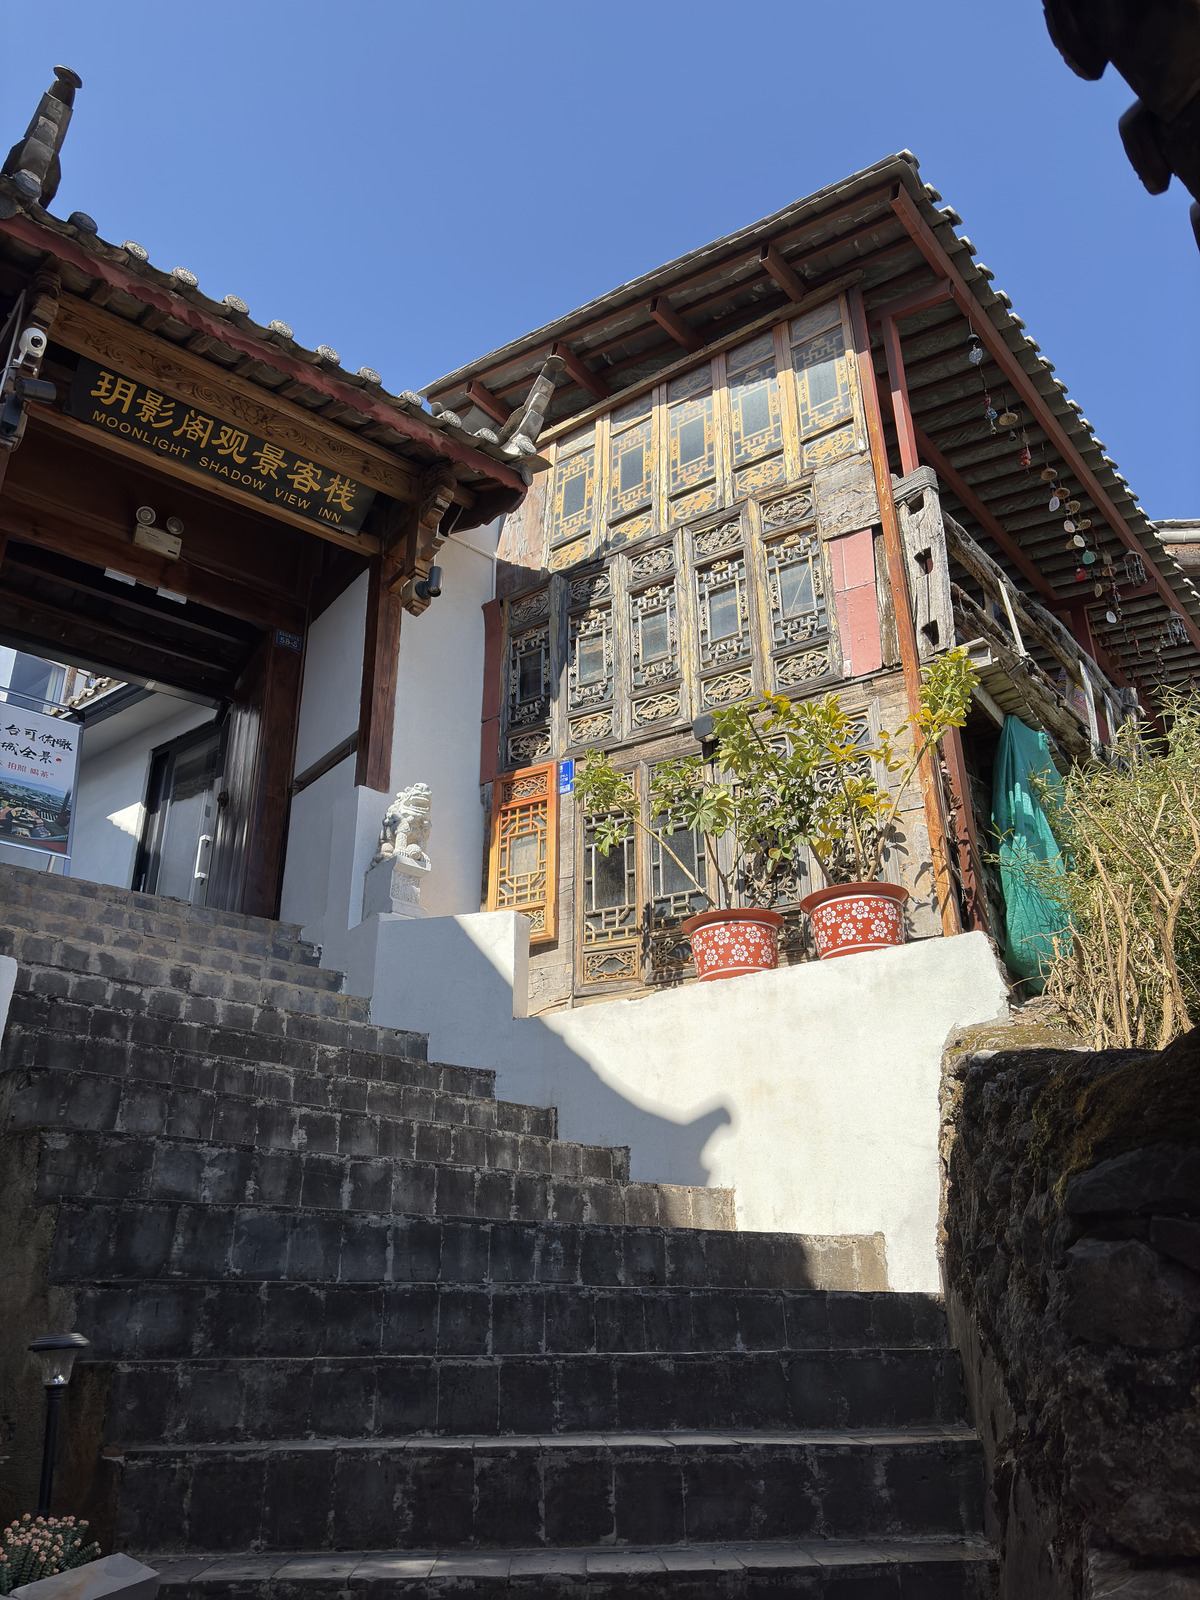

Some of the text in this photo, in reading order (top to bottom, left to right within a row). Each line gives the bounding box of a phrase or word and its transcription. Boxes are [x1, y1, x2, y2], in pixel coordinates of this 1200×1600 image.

[90, 371, 357, 512] 玥影阁观景客栈
[92, 410, 342, 524] MOONLIGHT SHADOW VIEW INN
[0, 723, 73, 751] 台可俯瞰
